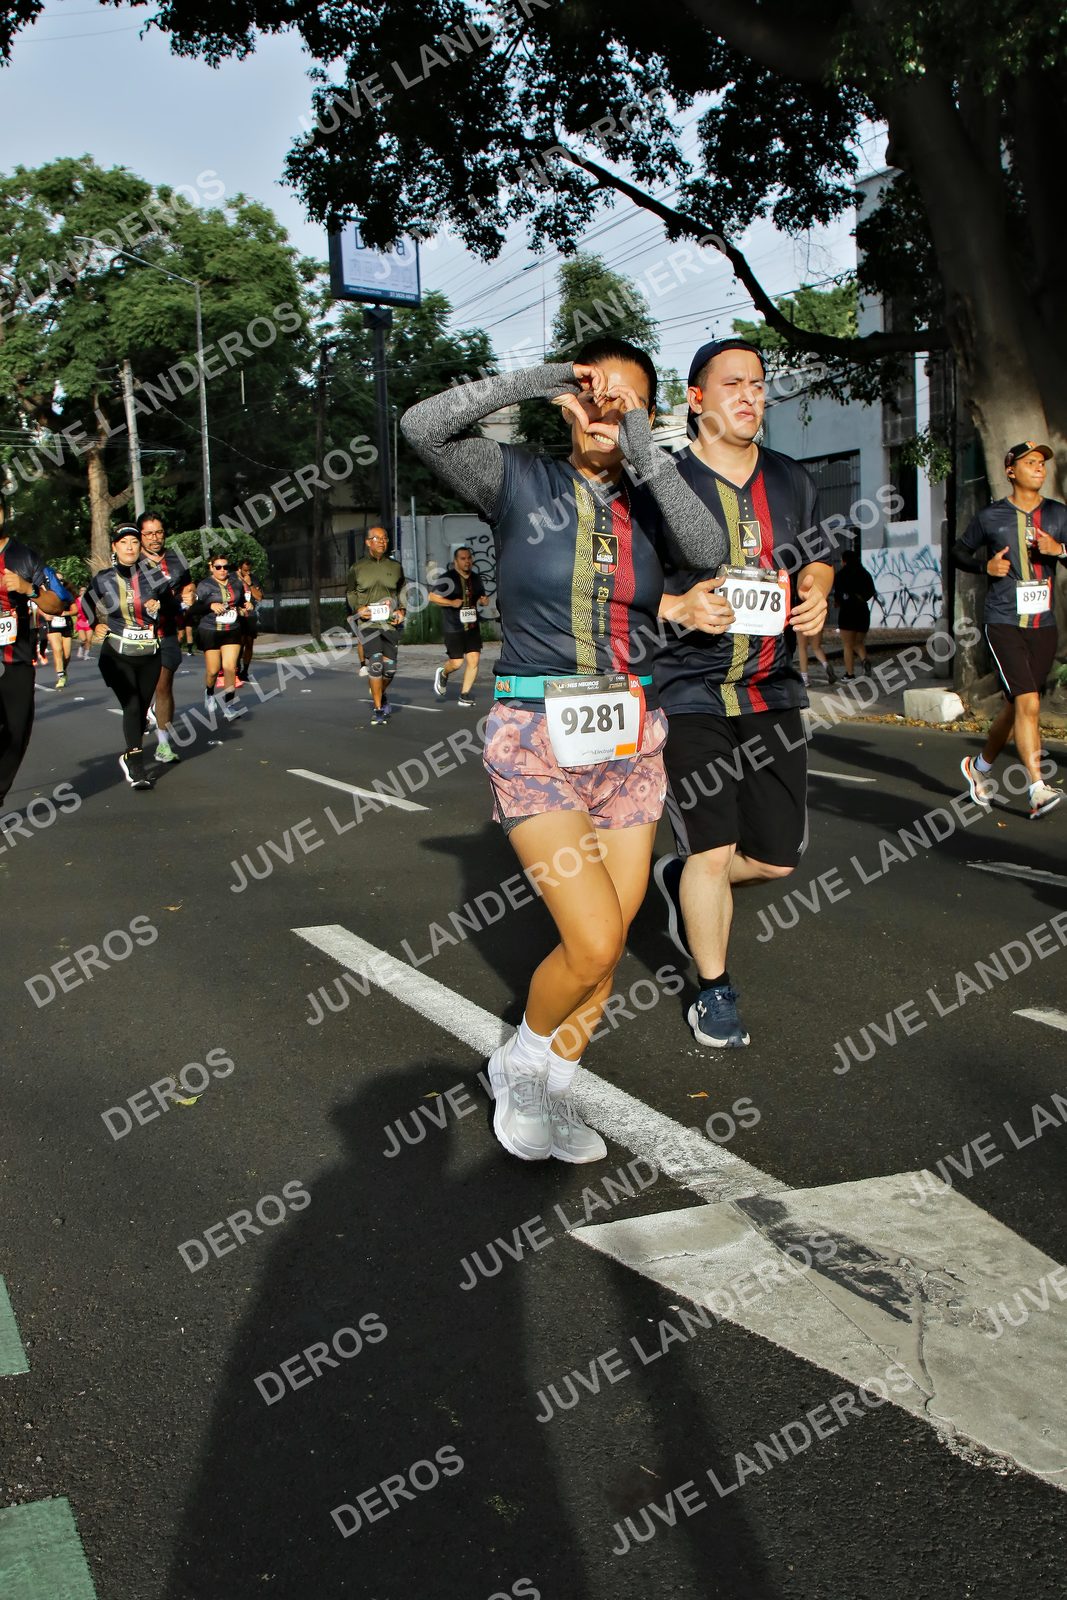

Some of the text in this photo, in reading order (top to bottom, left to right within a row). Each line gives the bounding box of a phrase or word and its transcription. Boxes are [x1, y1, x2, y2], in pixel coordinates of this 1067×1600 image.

[719, 587, 782, 612] 10078
[1023, 590, 1048, 602] 8979
[560, 702, 625, 736] 9281
